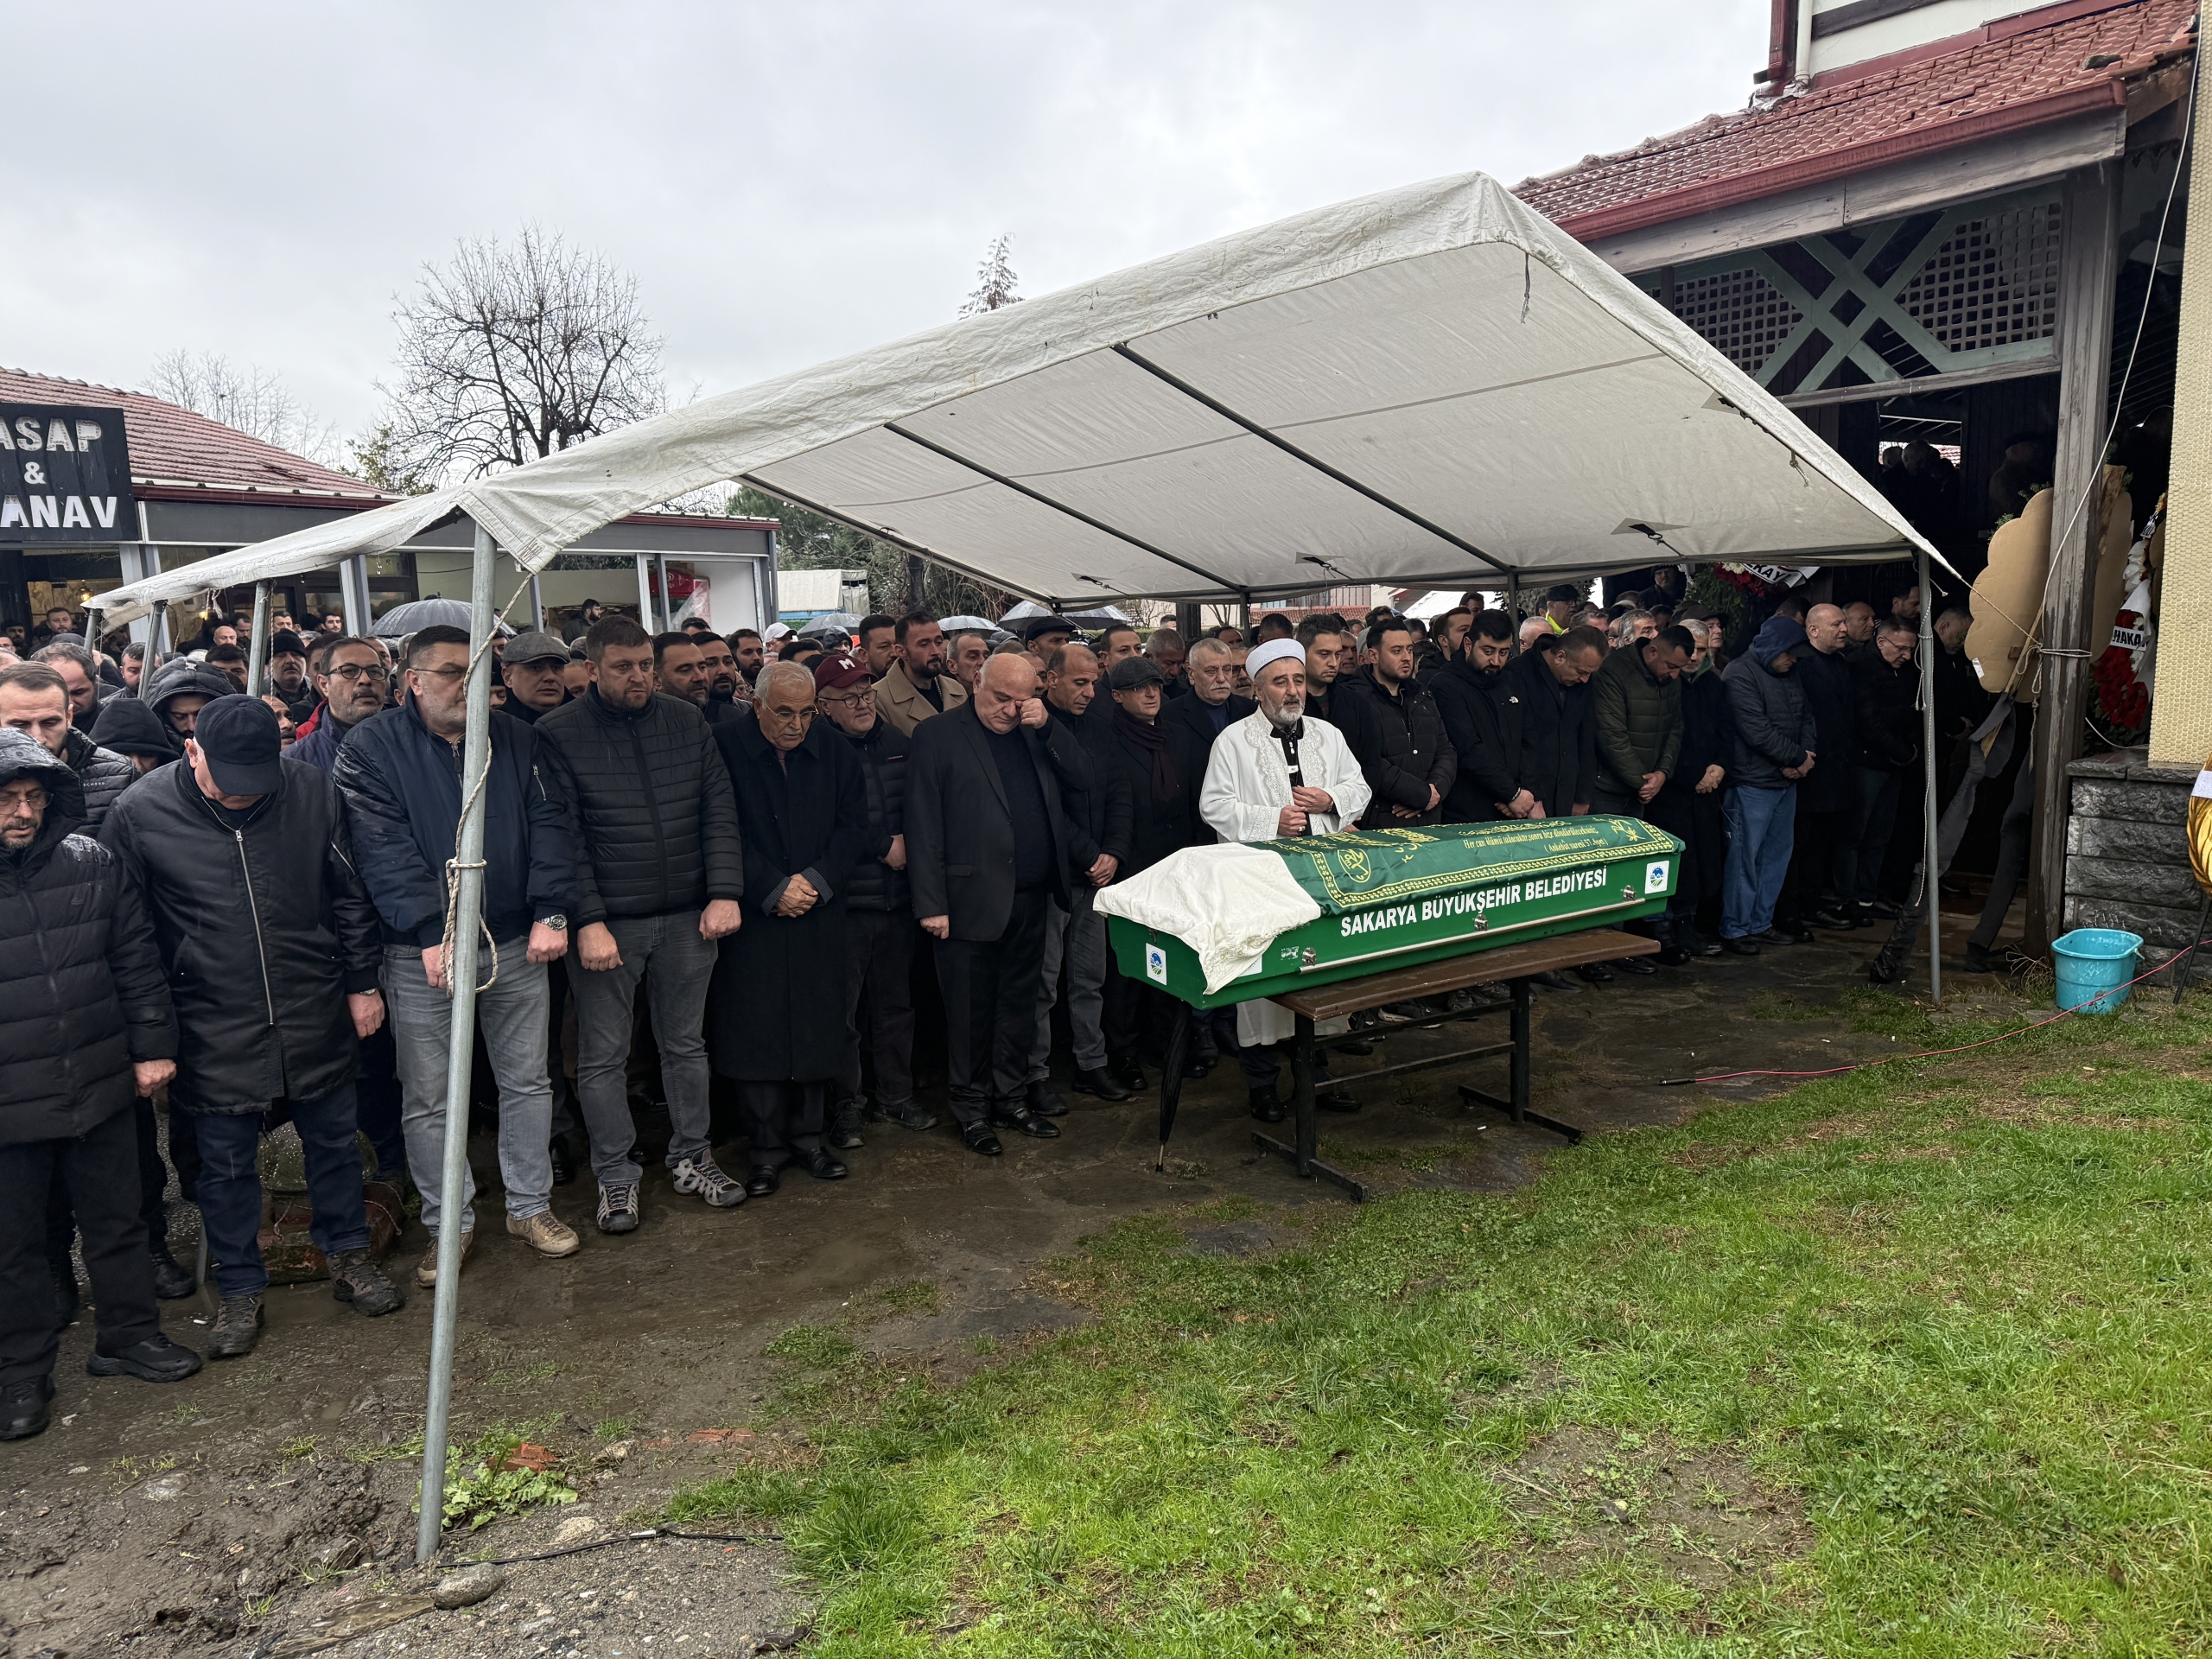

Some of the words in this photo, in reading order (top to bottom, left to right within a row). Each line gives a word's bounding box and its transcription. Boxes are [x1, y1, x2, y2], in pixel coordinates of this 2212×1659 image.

[23, 461, 47, 484] &
[838, 658, 856, 670] M
[1340, 903, 1417, 938] SAKARYA
[1421, 882, 1521, 922] BÜYÜKŞEHİR
[1524, 865, 1607, 901] BELEDİYESİ
